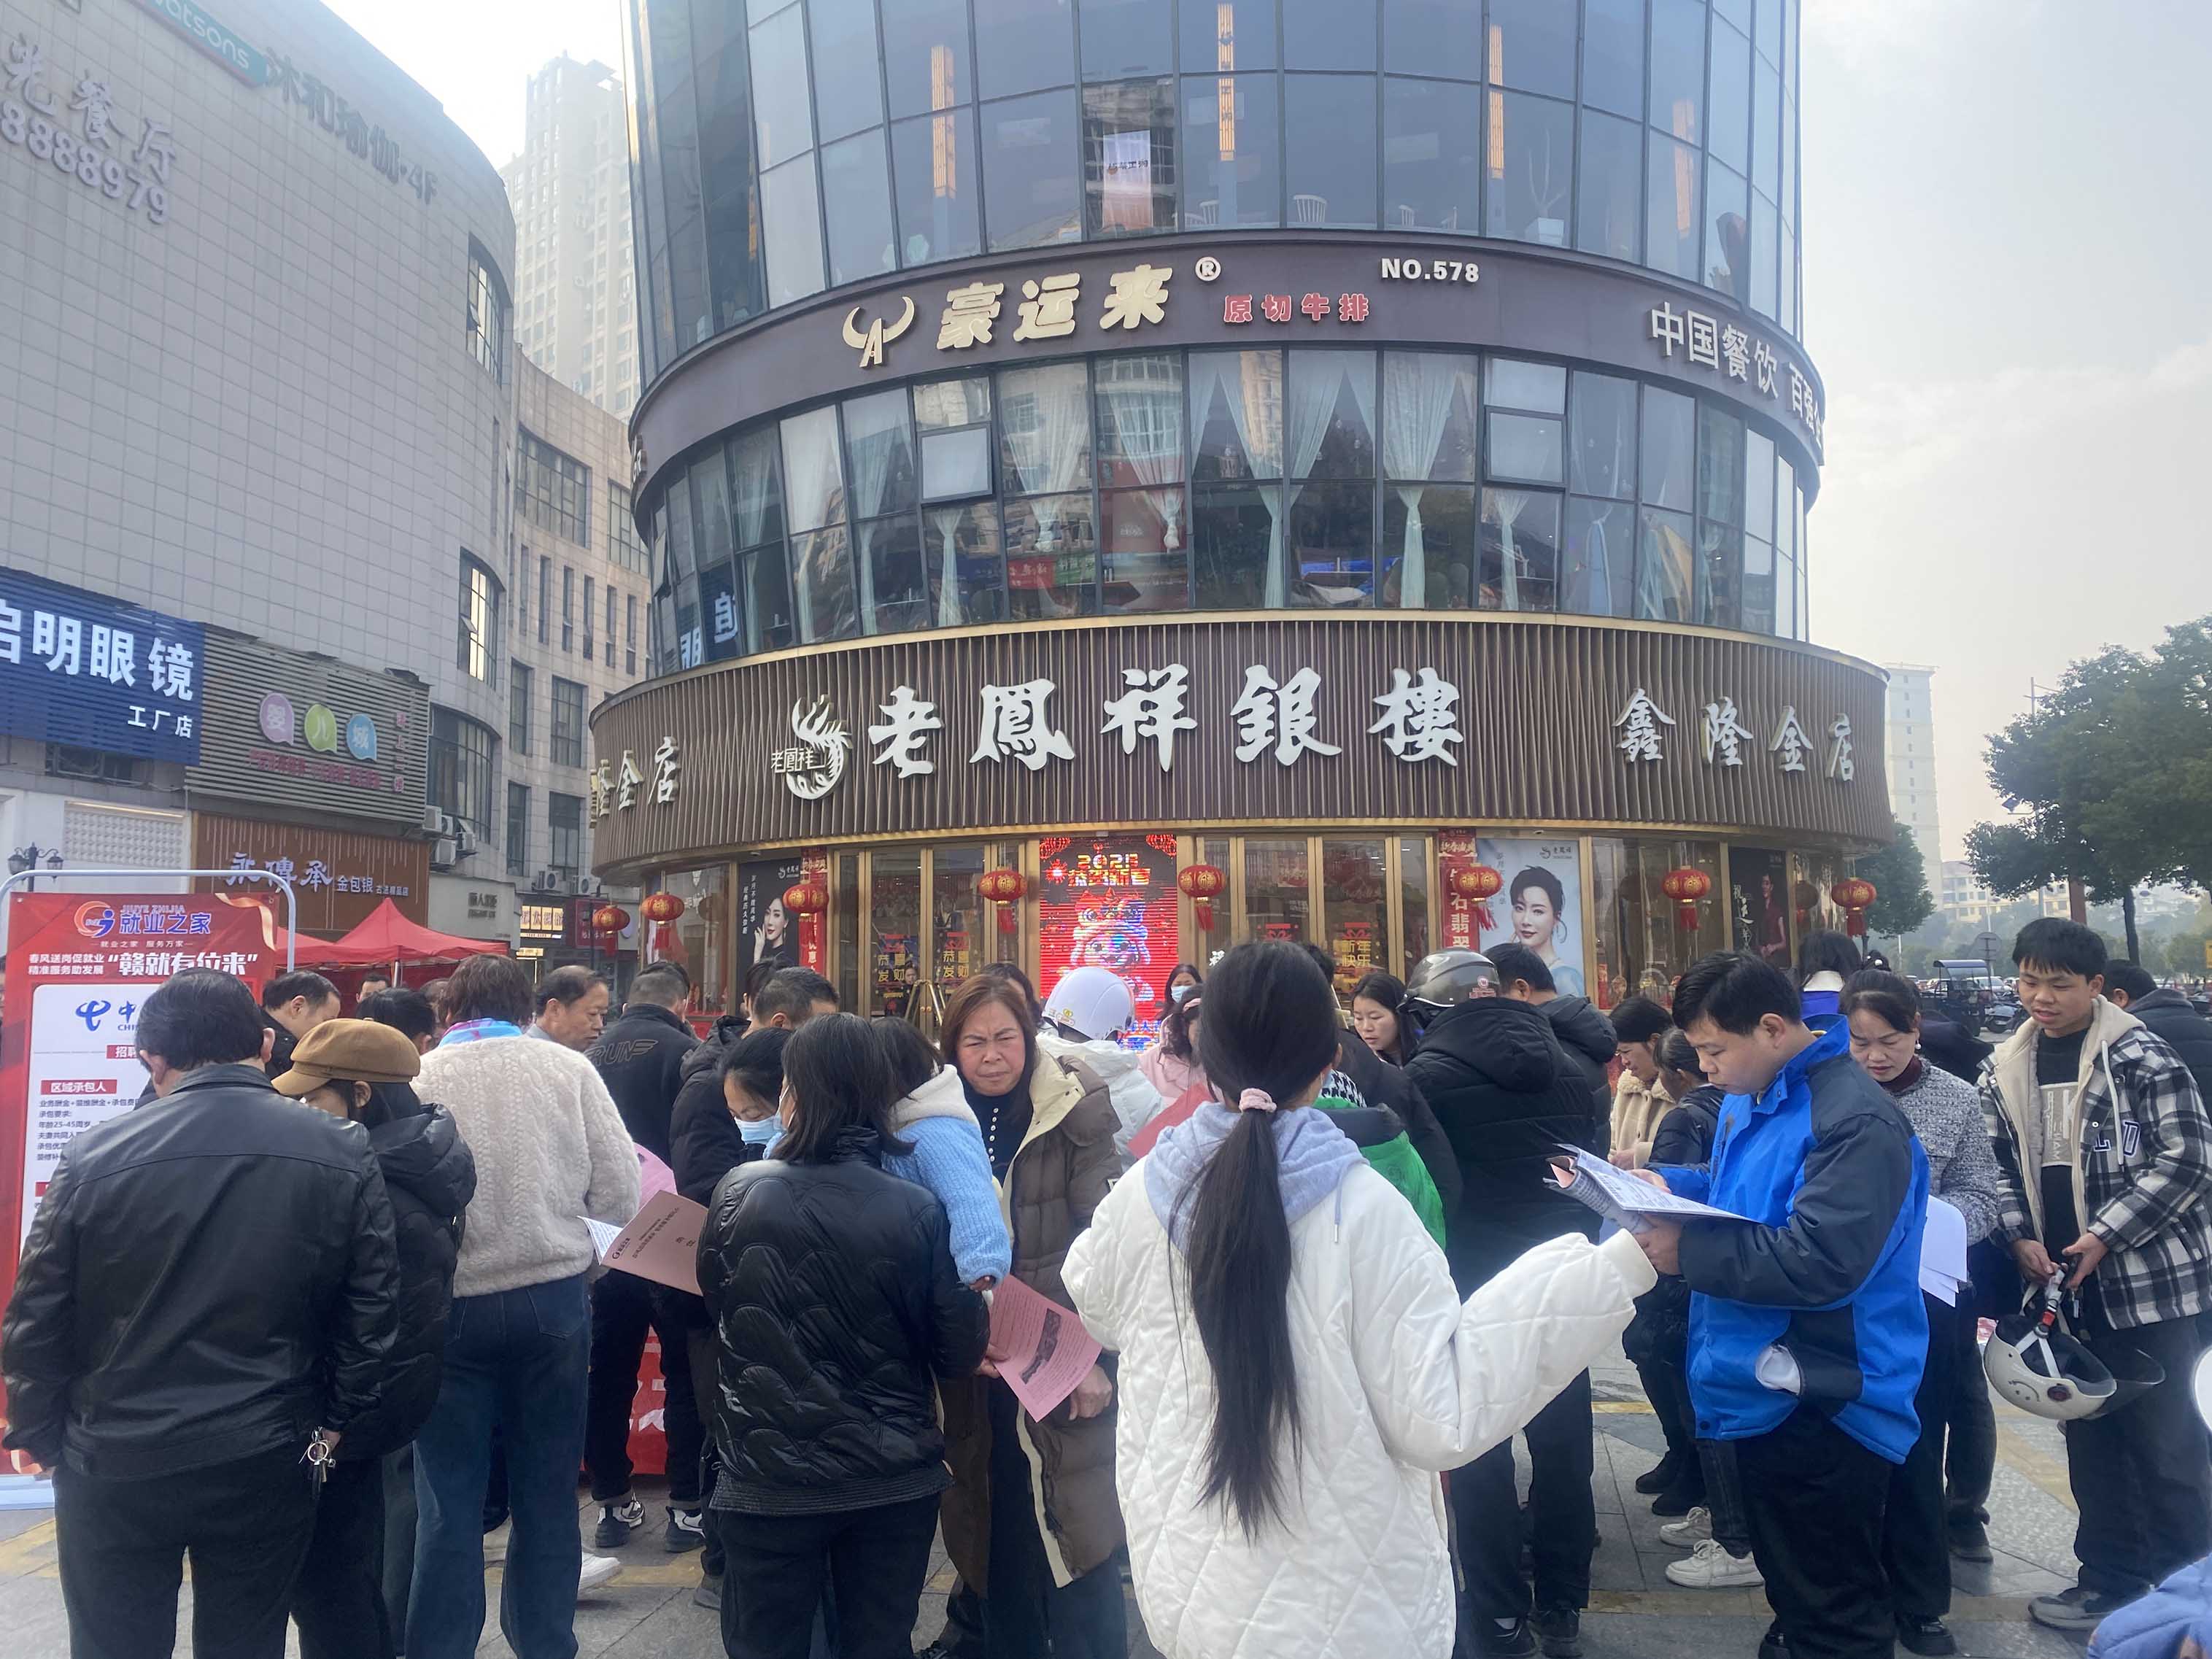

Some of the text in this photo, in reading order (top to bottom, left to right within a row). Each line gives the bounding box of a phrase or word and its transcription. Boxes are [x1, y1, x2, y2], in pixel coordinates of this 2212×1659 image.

[155, 0, 250, 70] atsons
[1380, 258, 1480, 284] NO.578
[936, 263, 1172, 350] 豪运来
[1223, 293, 1370, 323] 原切牛排
[1650, 301, 1779, 400] 中国餐饮
[0, 600, 194, 702] 启明眼镜
[127, 705, 193, 739] 工厂店
[336, 875, 374, 894] 金包银
[119, 912, 212, 934] 就业之家
[50, 1082, 107, 1093] 区域承包人
